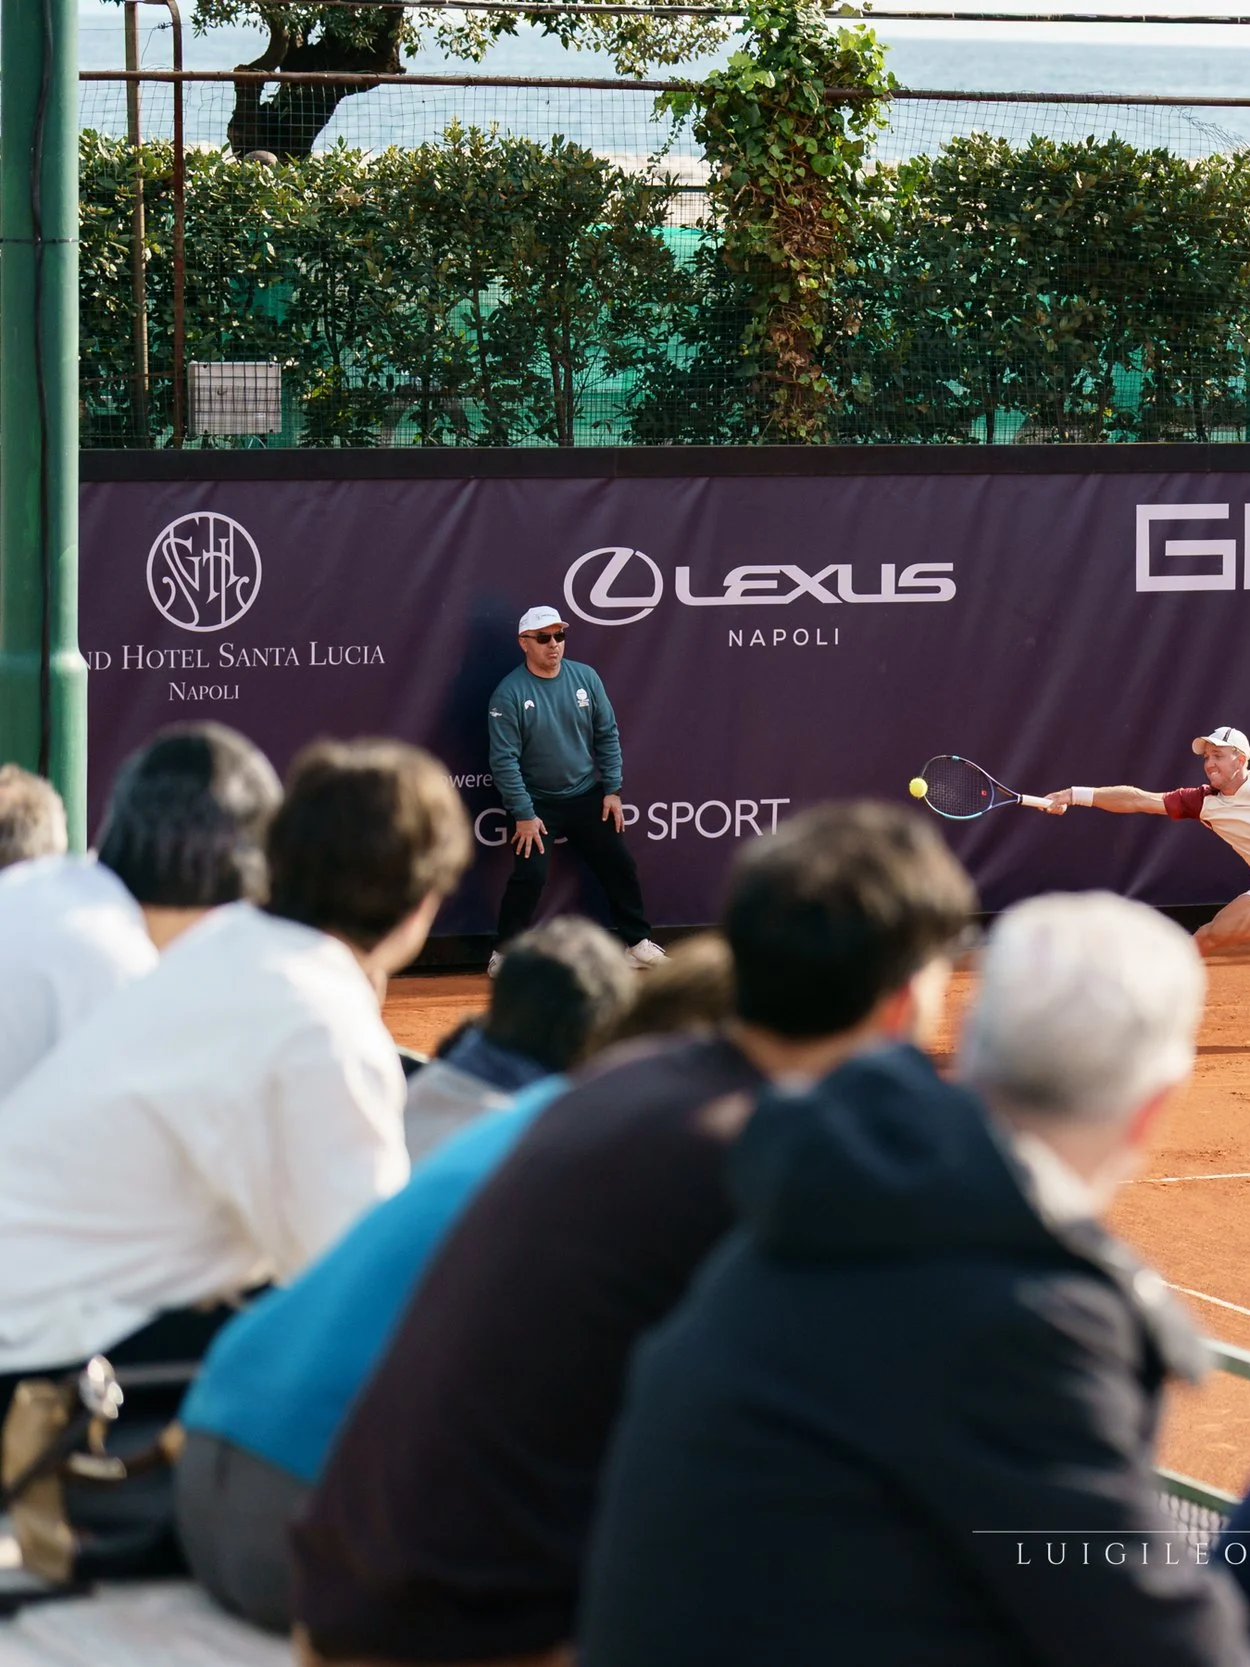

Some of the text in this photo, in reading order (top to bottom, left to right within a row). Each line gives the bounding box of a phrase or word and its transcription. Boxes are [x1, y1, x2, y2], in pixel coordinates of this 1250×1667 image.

[675, 562, 957, 607] LEXUS
[728, 627, 840, 648] NAPOLI
[647, 798, 790, 841] SPORT
